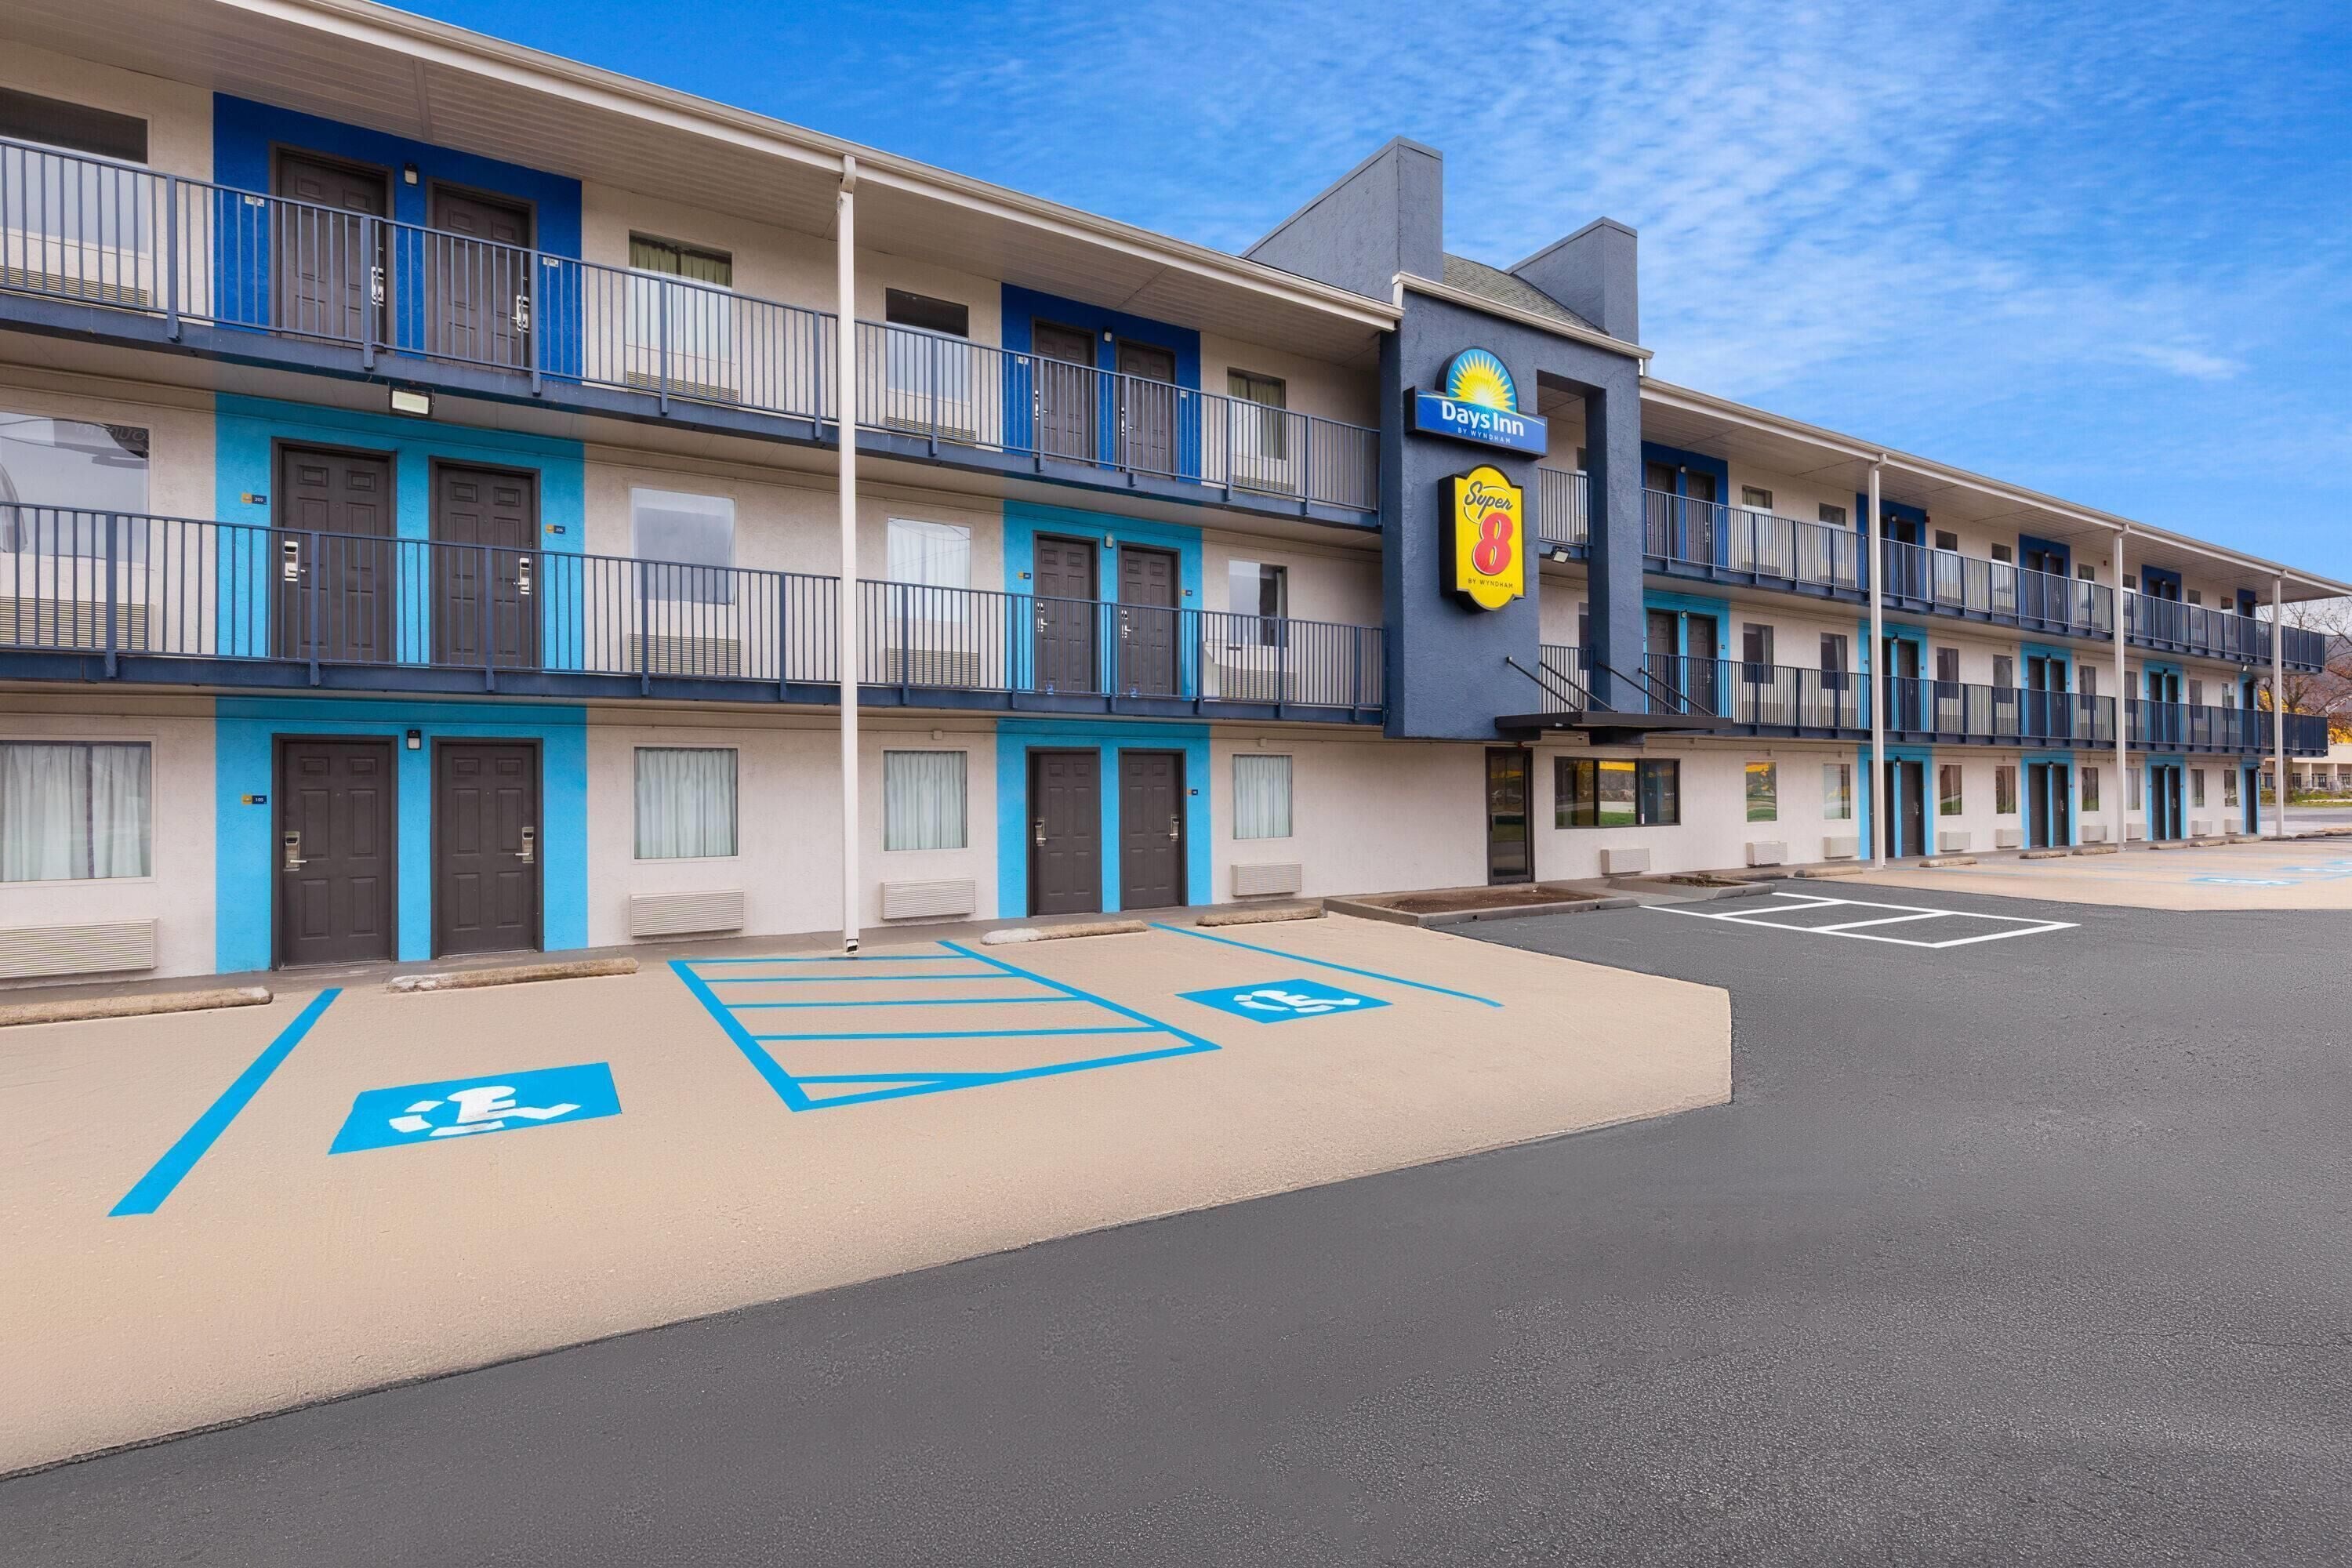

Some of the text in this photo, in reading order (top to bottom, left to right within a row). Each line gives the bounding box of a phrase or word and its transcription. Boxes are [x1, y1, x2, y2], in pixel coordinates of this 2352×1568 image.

[1442, 400, 1525, 437] Days Inn
[1457, 426, 1511, 445] BY WYNDHAM
[1464, 481, 1513, 520] Super
[1472, 512, 1513, 576] 8
[1479, 579, 1513, 589] WYNDHAM
